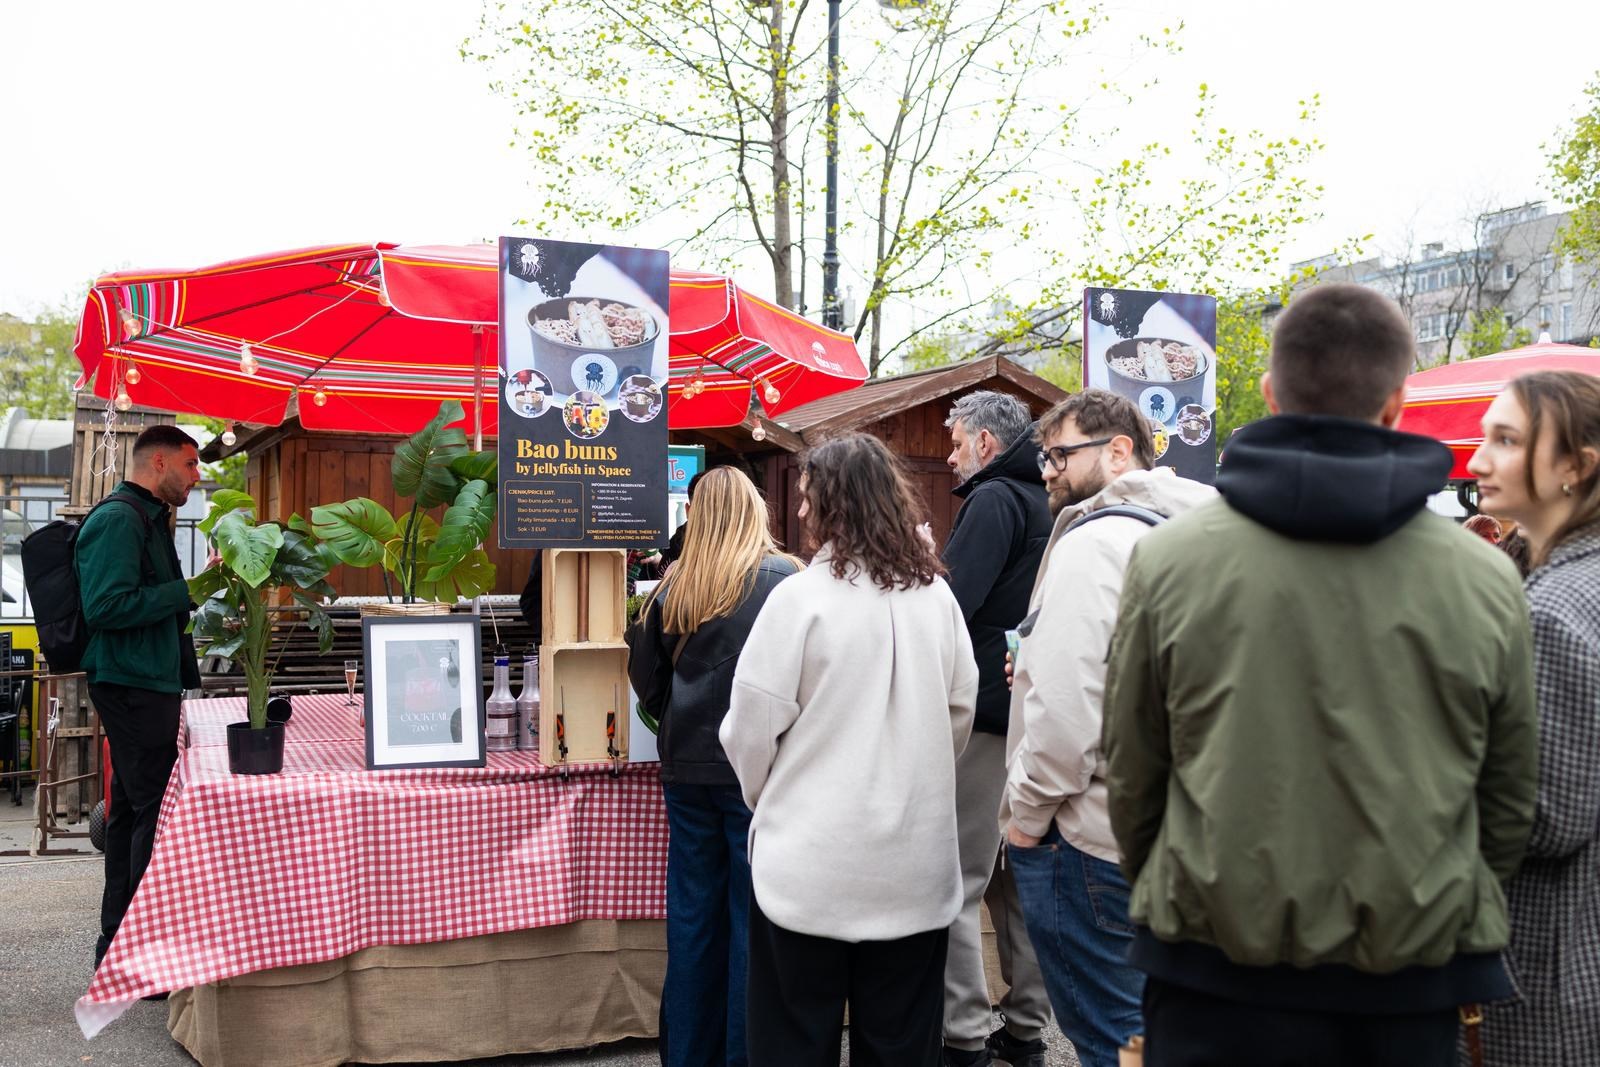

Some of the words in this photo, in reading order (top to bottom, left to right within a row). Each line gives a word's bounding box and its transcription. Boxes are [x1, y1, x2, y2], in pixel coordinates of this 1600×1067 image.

[516, 439, 559, 459] Bao
[564, 439, 618, 461] buns
[515, 462, 531, 476] by
[533, 462, 582, 476] Jellyfish
[584, 463, 596, 475] in
[598, 465, 631, 477] Space
[400, 712, 448, 721] COCKTAIL
